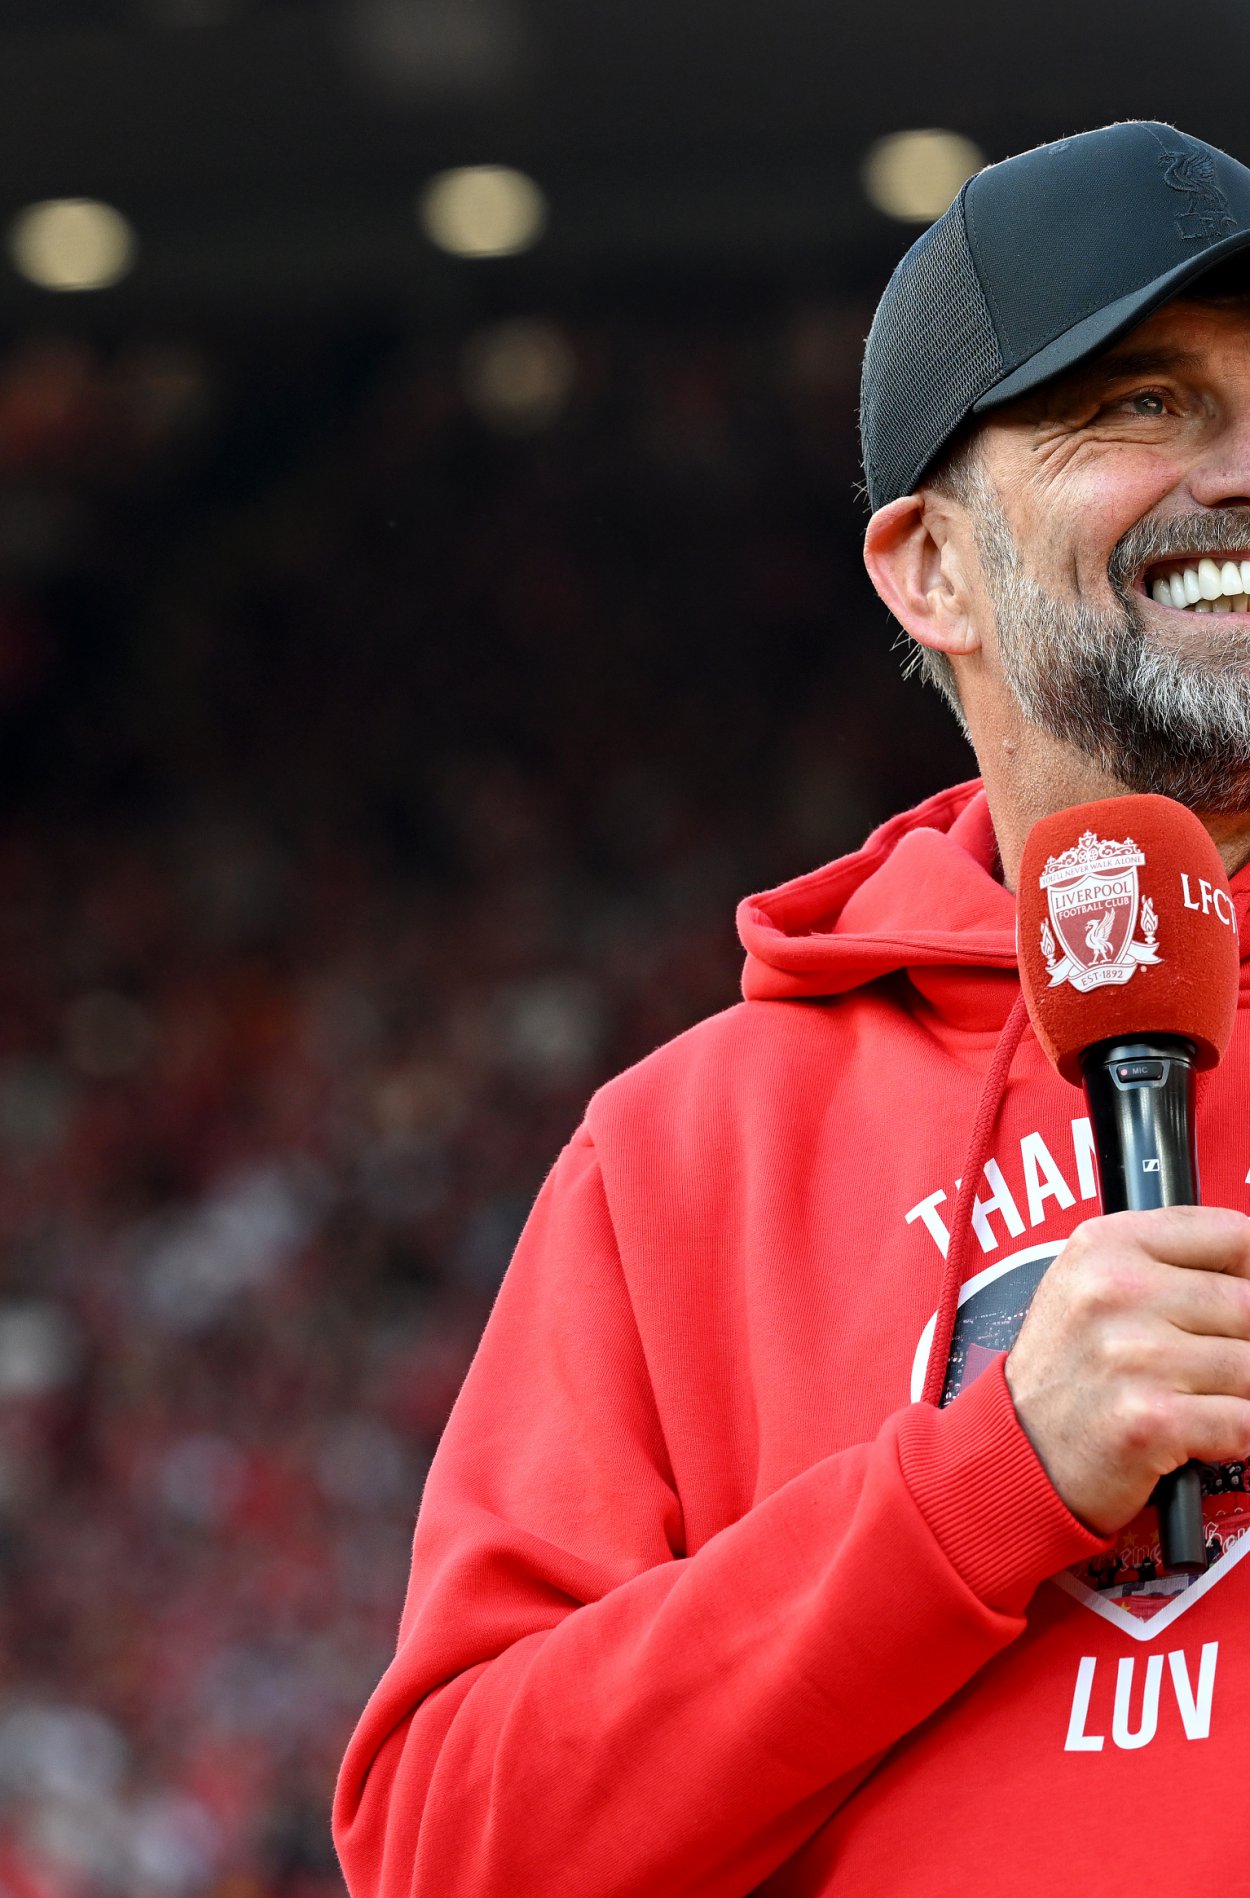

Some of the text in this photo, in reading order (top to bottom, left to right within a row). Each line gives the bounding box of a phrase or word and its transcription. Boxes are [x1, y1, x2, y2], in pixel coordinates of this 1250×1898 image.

[1065, 865, 1089, 876] NEVER
[1090, 861, 1112, 870] WALK
[1114, 856, 1141, 865] ALONE
[1055, 881, 1131, 910] LIVERPOOL
[1059, 897, 1129, 920] FOOTBALL CLUB
[1181, 873, 1237, 934] LFCT
[1132, 1066, 1149, 1075] MIC
[905, 1117, 1098, 1260] THAN
[1063, 1641, 1219, 1752] LUV
